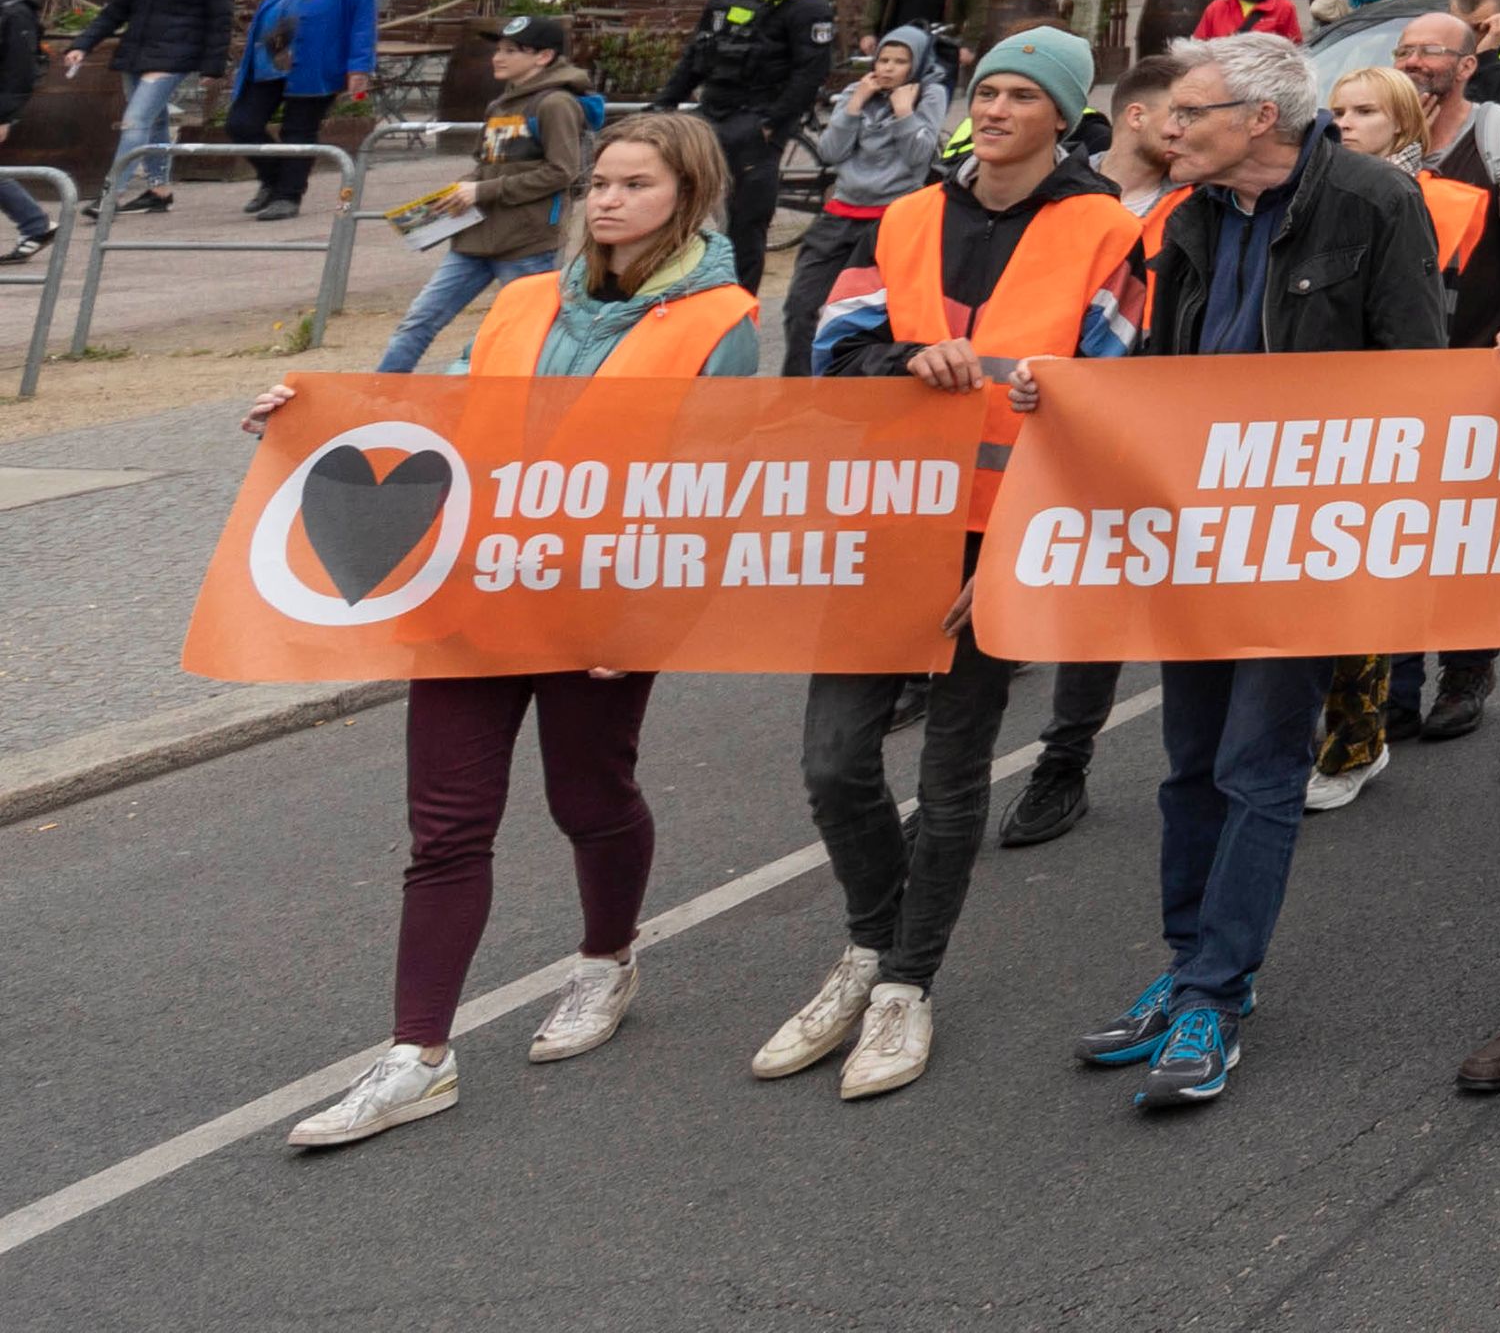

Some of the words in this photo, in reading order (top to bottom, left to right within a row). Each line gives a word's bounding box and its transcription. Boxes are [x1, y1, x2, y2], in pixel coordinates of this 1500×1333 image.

[1197, 416, 1424, 491] MEHR
[487, 461, 607, 519] 100
[623, 461, 817, 519] KM/H
[826, 460, 961, 516] UND
[474, 534, 561, 592] 9€
[579, 524, 707, 590] FÜR
[720, 531, 868, 587] ALLE
